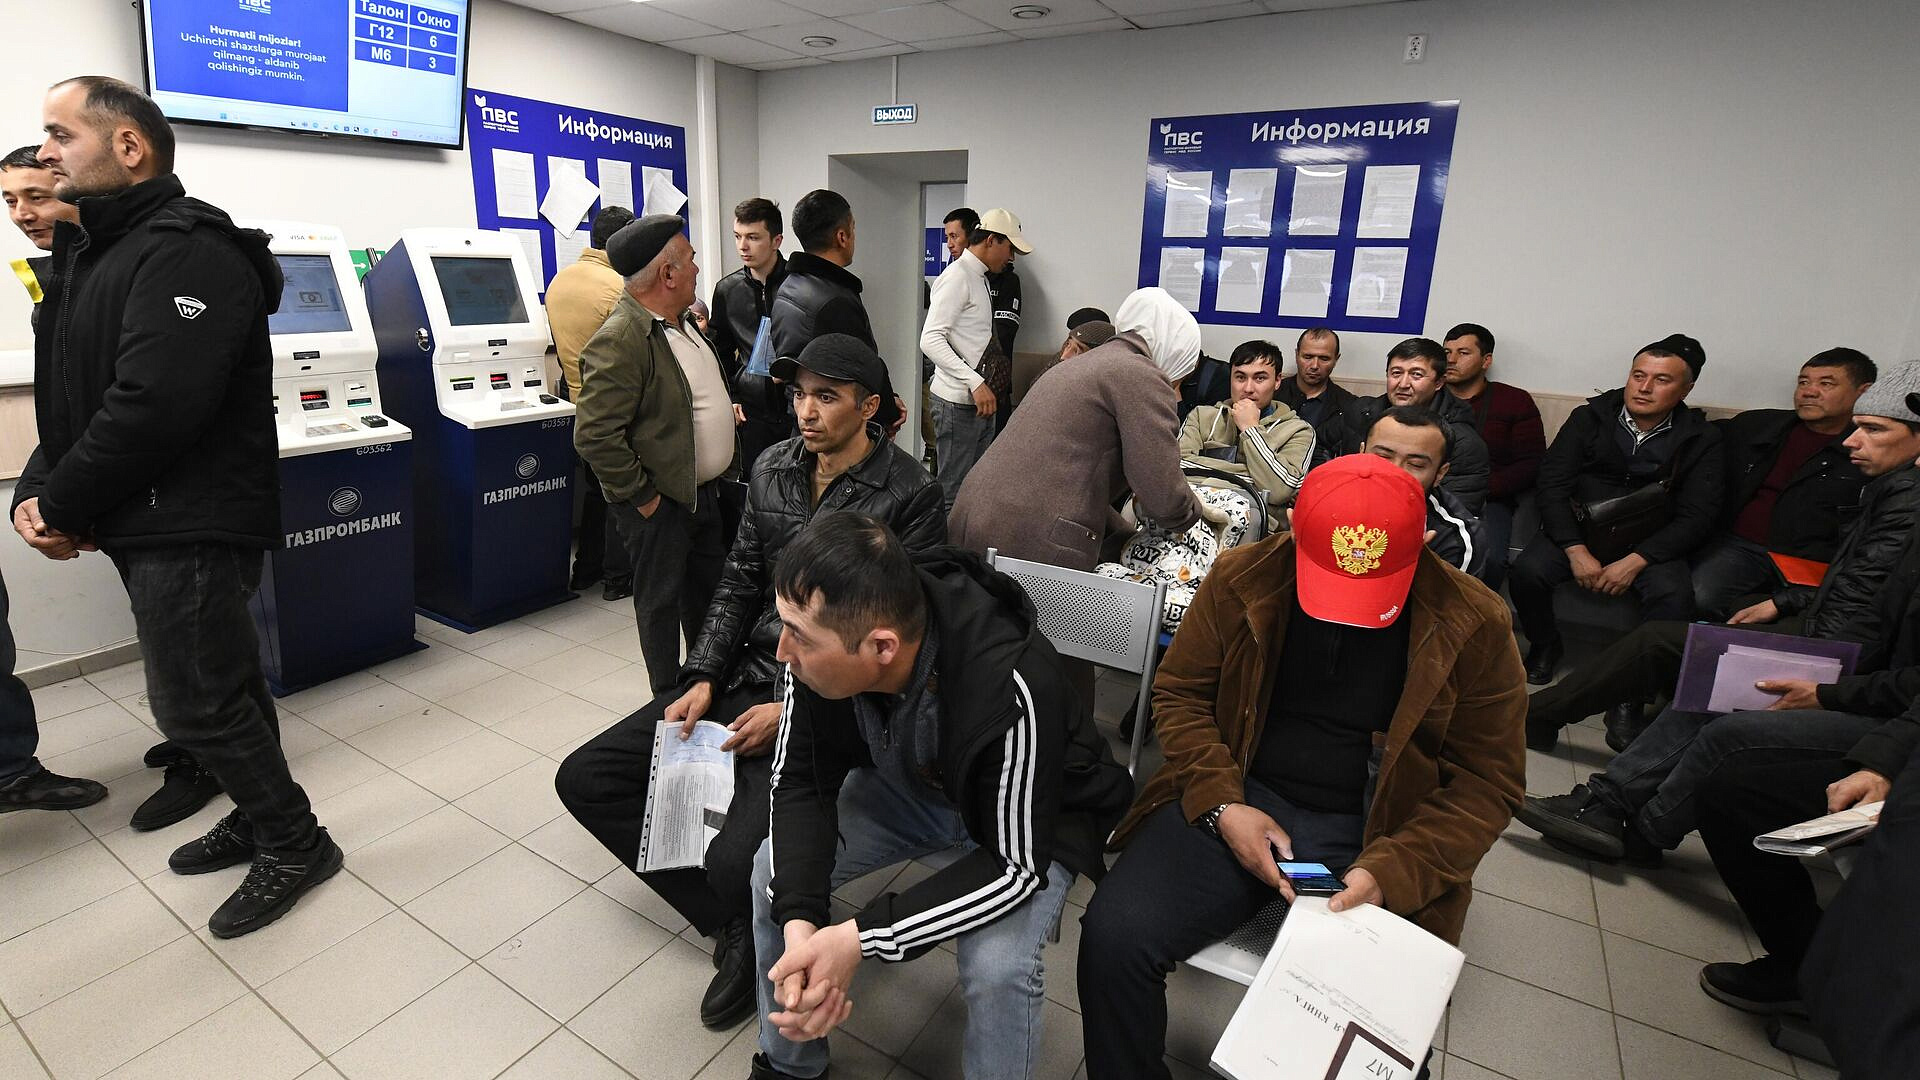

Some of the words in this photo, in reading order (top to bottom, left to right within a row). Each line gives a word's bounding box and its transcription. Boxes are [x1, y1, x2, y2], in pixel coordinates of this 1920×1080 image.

[361, 0, 404, 19] Талон
[417, 11, 451, 29] Окно
[209, 25, 256, 41] Hurmatli
[369, 23, 394, 40] Г12
[180, 32, 228, 48] Uchinchi
[230, 40, 283, 57] shaxslarga
[285, 49, 327, 63] murojaat
[429, 35, 438, 48] 6
[213, 50, 255, 64] qilmang
[264, 58, 299, 70] aldanib
[371, 46, 392, 61] М6
[207, 61, 263, 76] qolishingiz
[265, 69, 305, 81] mumkin.
[428, 57, 437, 69] 3
[481, 107, 518, 125] ПВС
[876, 106, 913, 121] ВЫХОД
[558, 114, 673, 149] Информация
[1164, 131, 1203, 146] ПВС
[1250, 118, 1430, 145] Информация
[483, 476, 567, 505] ГАЗПРОМБАНК
[285, 511, 401, 549] ГАЗПРОМБАНК
[1296, 995, 1329, 1023] КНИГА
